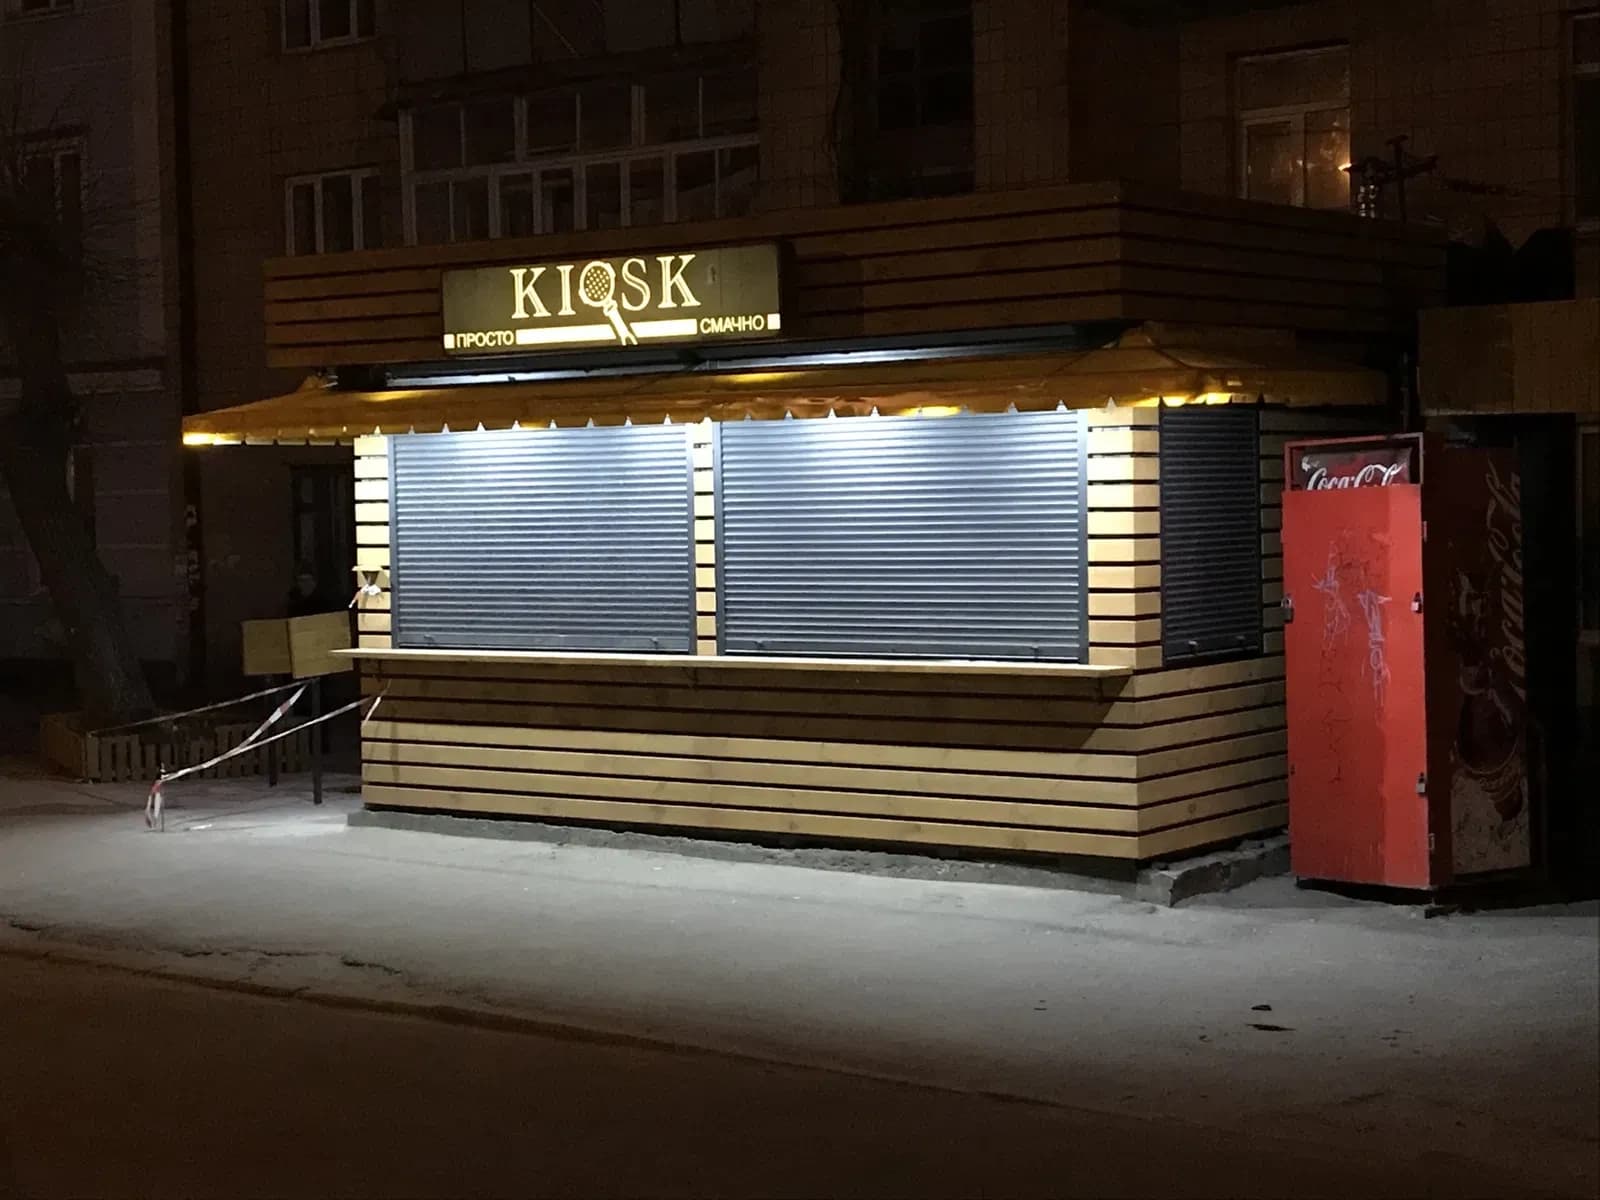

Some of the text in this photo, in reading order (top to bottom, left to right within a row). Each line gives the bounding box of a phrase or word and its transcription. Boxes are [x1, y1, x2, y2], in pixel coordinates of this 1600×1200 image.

[509, 253, 702, 319] KIOSK
[456, 313, 765, 349] ПРОСТО СМАЧНО
[1306, 462, 1407, 491] Coca-Cl
